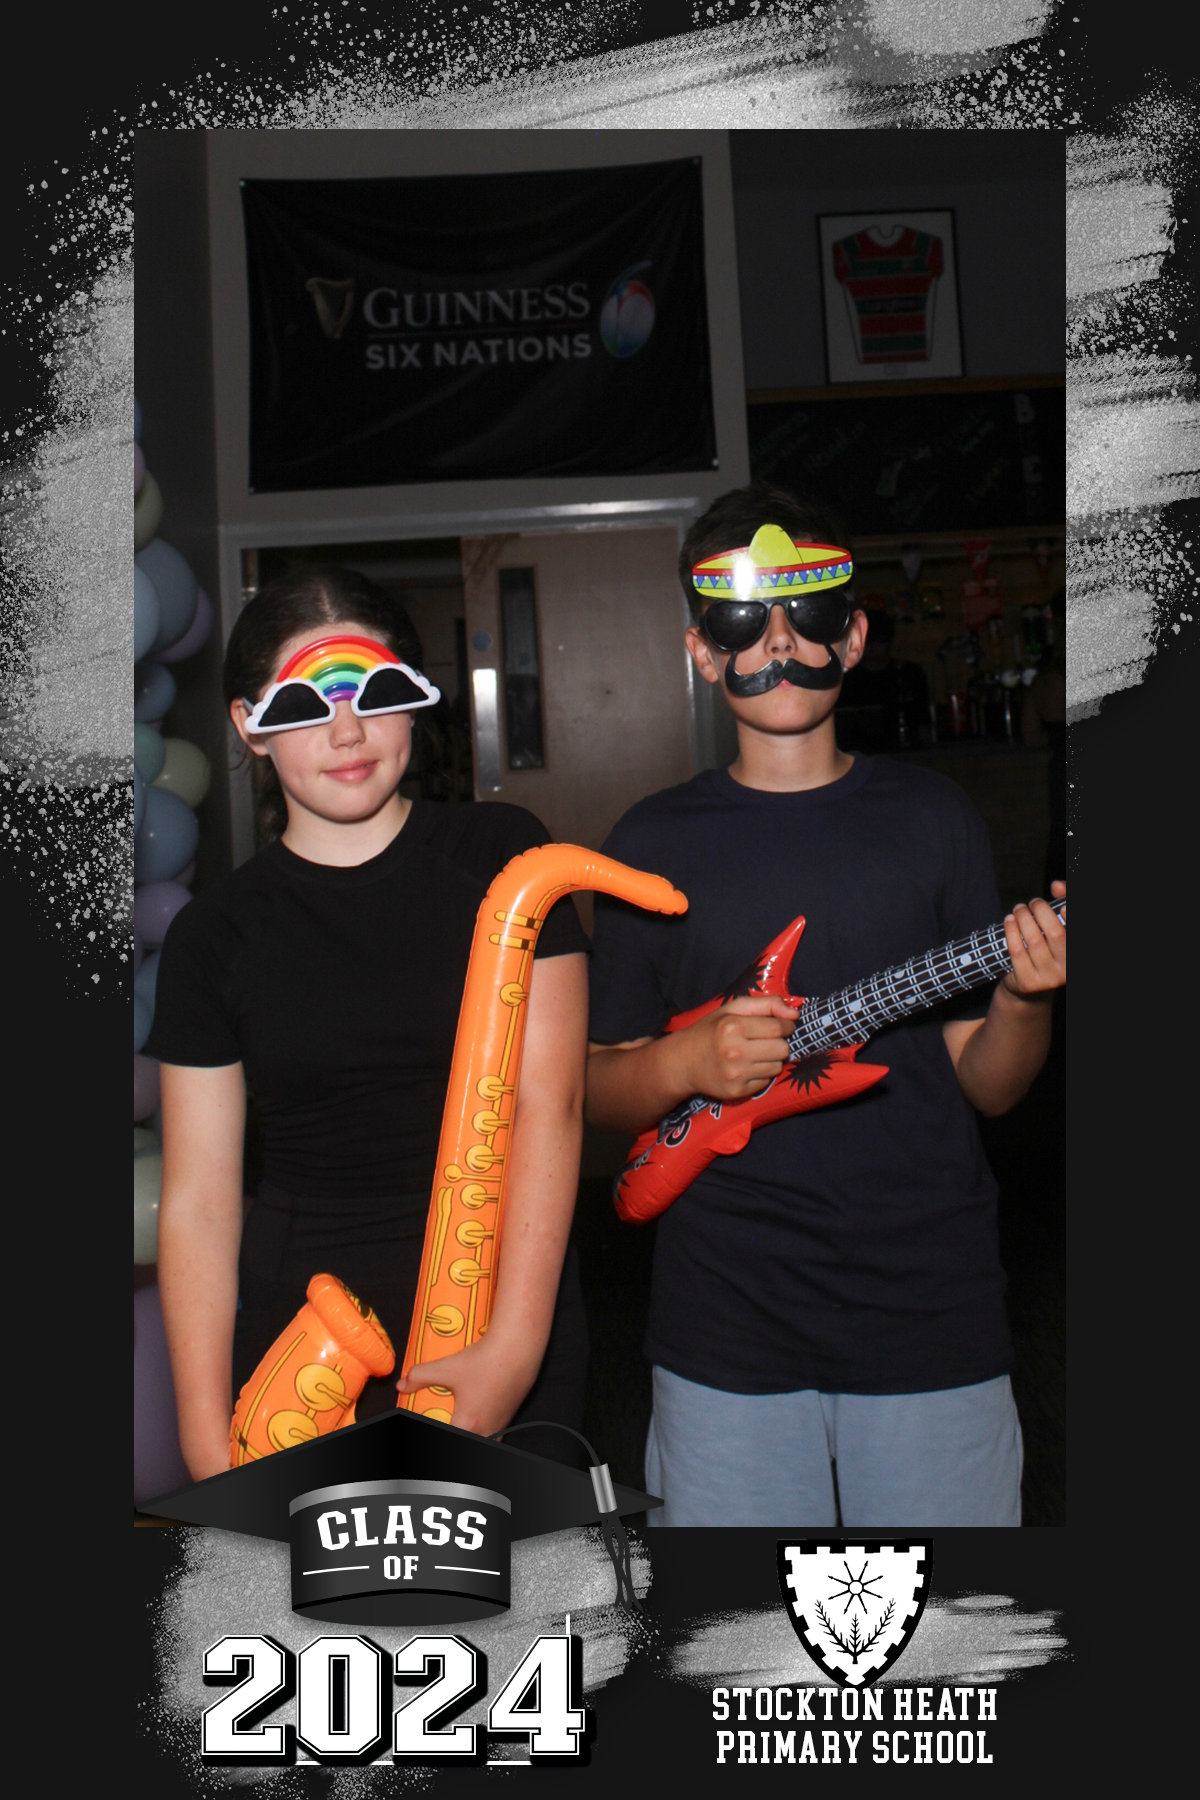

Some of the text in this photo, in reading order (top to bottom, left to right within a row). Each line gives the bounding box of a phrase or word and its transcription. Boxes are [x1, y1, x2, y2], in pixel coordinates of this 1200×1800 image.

[363, 283, 591, 329] GUINNESS
[366, 334, 592, 370] SIX NATIONS
